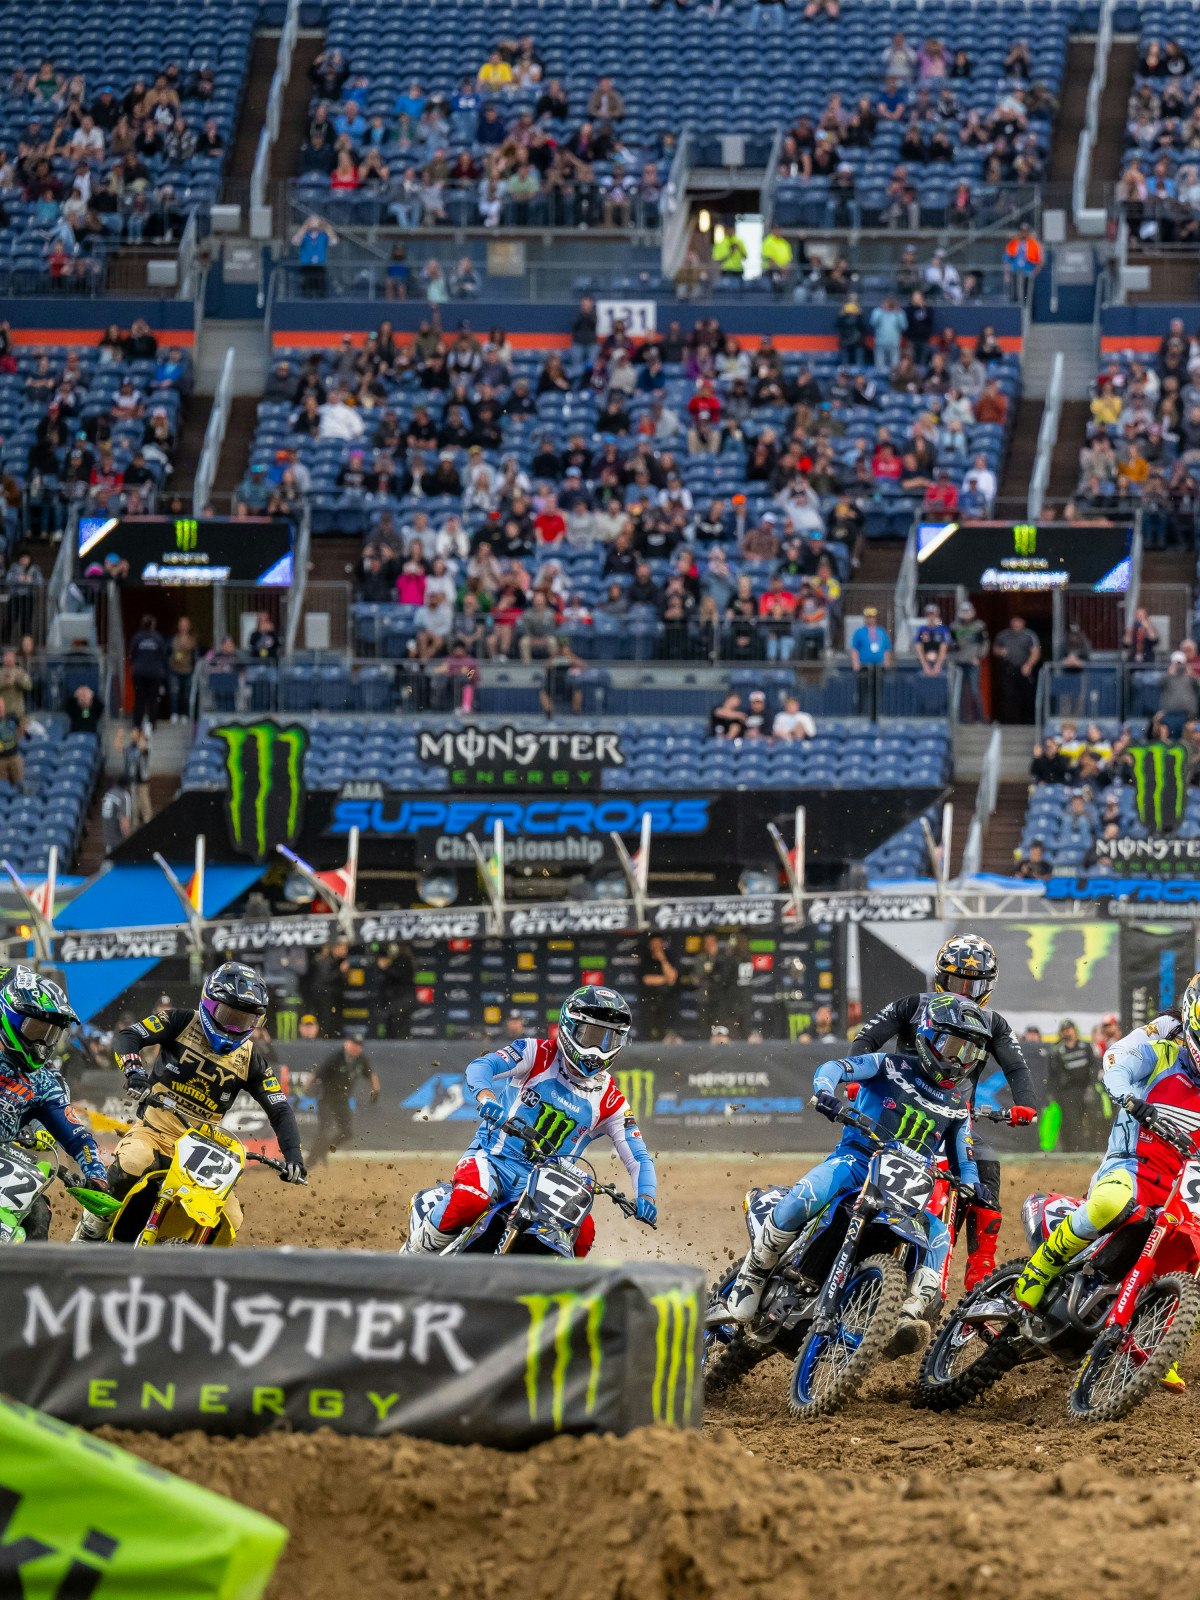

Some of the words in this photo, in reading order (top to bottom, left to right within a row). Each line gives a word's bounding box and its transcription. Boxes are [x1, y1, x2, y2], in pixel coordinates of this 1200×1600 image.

[420, 728, 623, 765] MONSTER
[342, 782, 384, 801] AMA
[452, 770, 592, 785] ENERGY
[331, 799, 709, 835] SUPERCROSS
[179, 1048, 236, 1087] FLY
[171, 1079, 206, 1104] TWISTED
[204, 1097, 219, 1112] TEA
[521, 1091, 539, 1106] PPG
[557, 1096, 580, 1114] YAMAHA
[919, 1082, 946, 1101] YAMAHA
[183, 1145, 234, 1186] 12
[878, 1158, 932, 1210] 32
[827, 1250, 849, 1301] DUNLOP
[1117, 1268, 1141, 1312] DUNLOP
[21, 1276, 479, 1374] MONSTER
[87, 1377, 400, 1422] ENERGY
